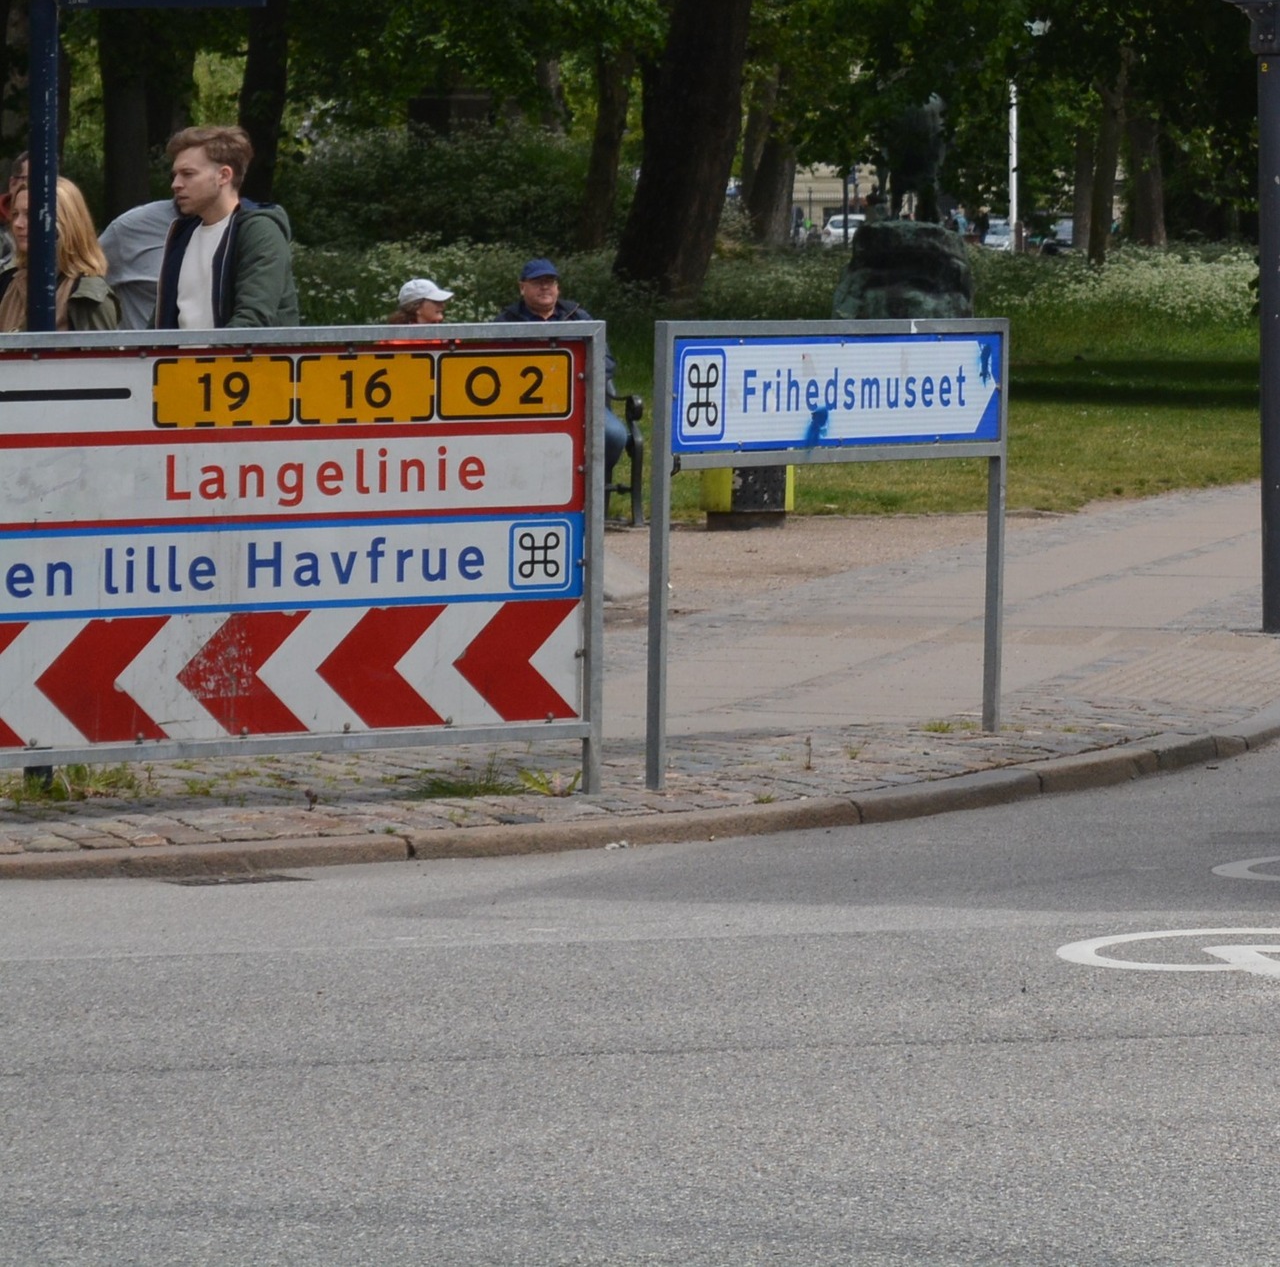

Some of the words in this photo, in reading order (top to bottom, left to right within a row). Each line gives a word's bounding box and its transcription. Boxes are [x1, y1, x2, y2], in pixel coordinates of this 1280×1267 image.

[1261, 63, 1268, 72] 2
[198, 371, 250, 413] 19
[340, 368, 392, 409] 16
[742, 364, 967, 414] Frihedsmuseet
[165, 445, 486, 507] Langelinie
[104, 545, 216, 594] lille
[247, 536, 485, 589] Havfrue
